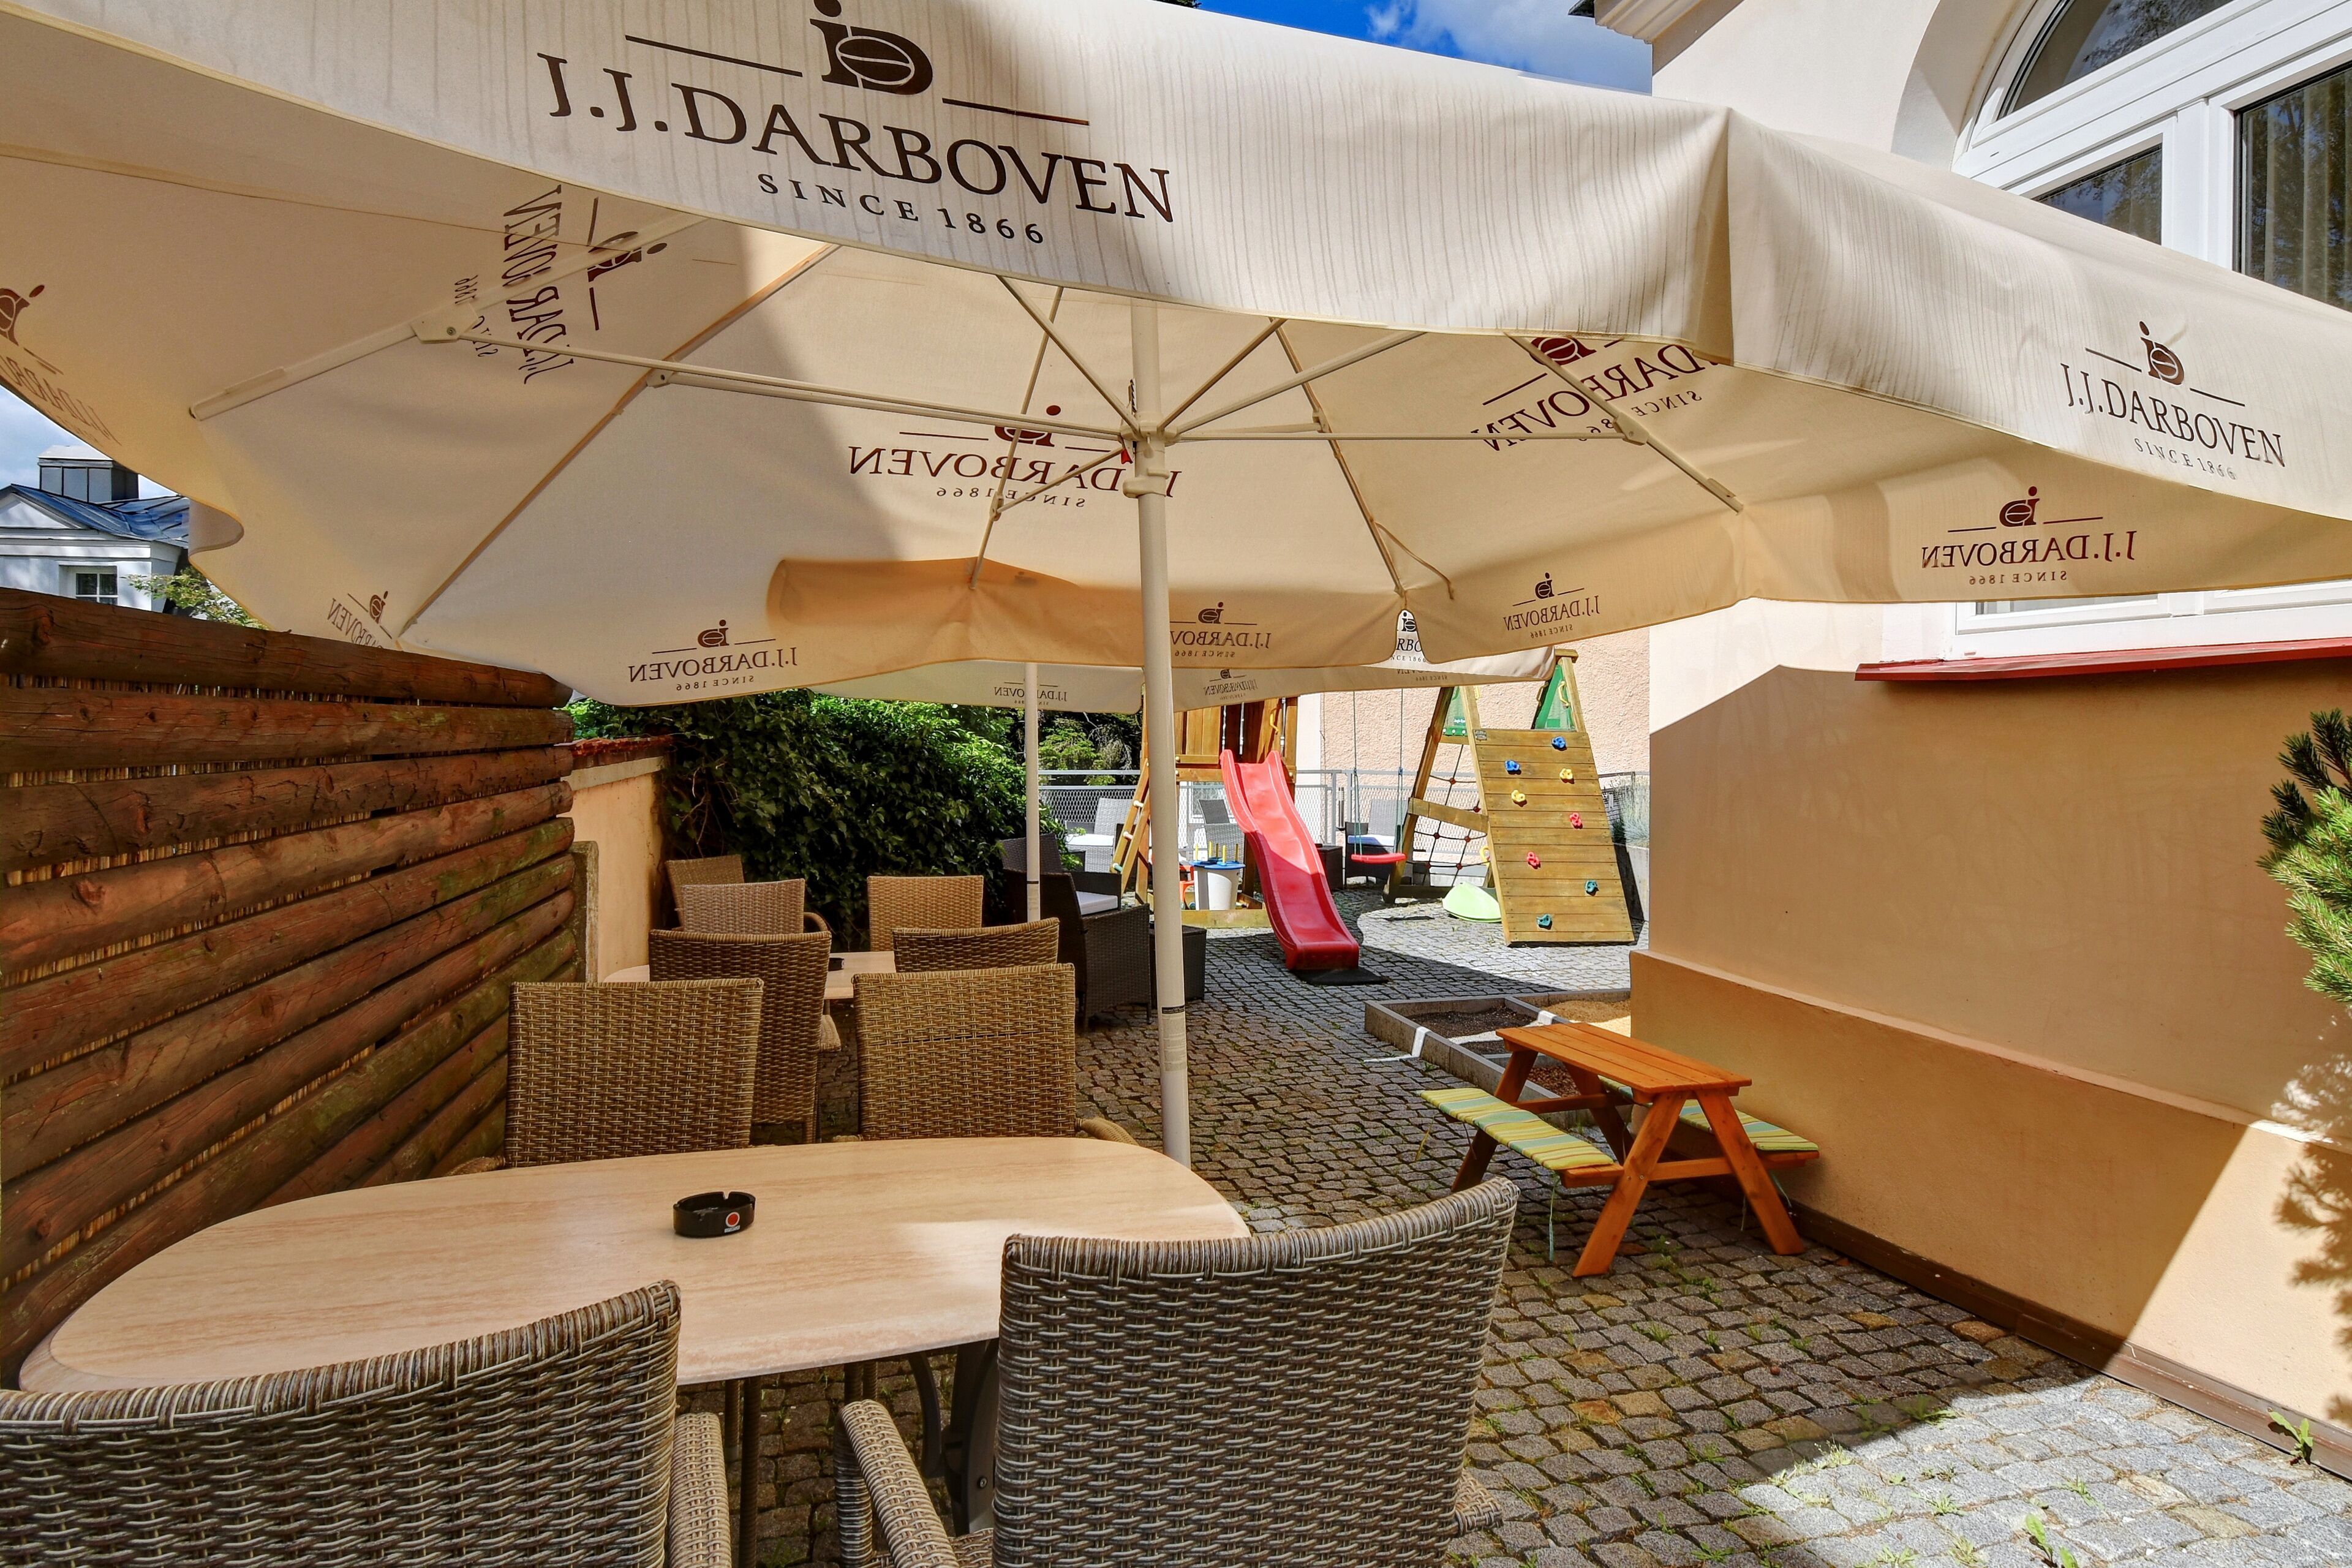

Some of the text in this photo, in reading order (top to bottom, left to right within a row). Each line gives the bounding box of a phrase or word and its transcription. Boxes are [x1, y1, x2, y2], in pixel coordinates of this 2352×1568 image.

[760, 173, 1044, 244] SINCE 1866
[2134, 438, 2193, 467] SINCE
